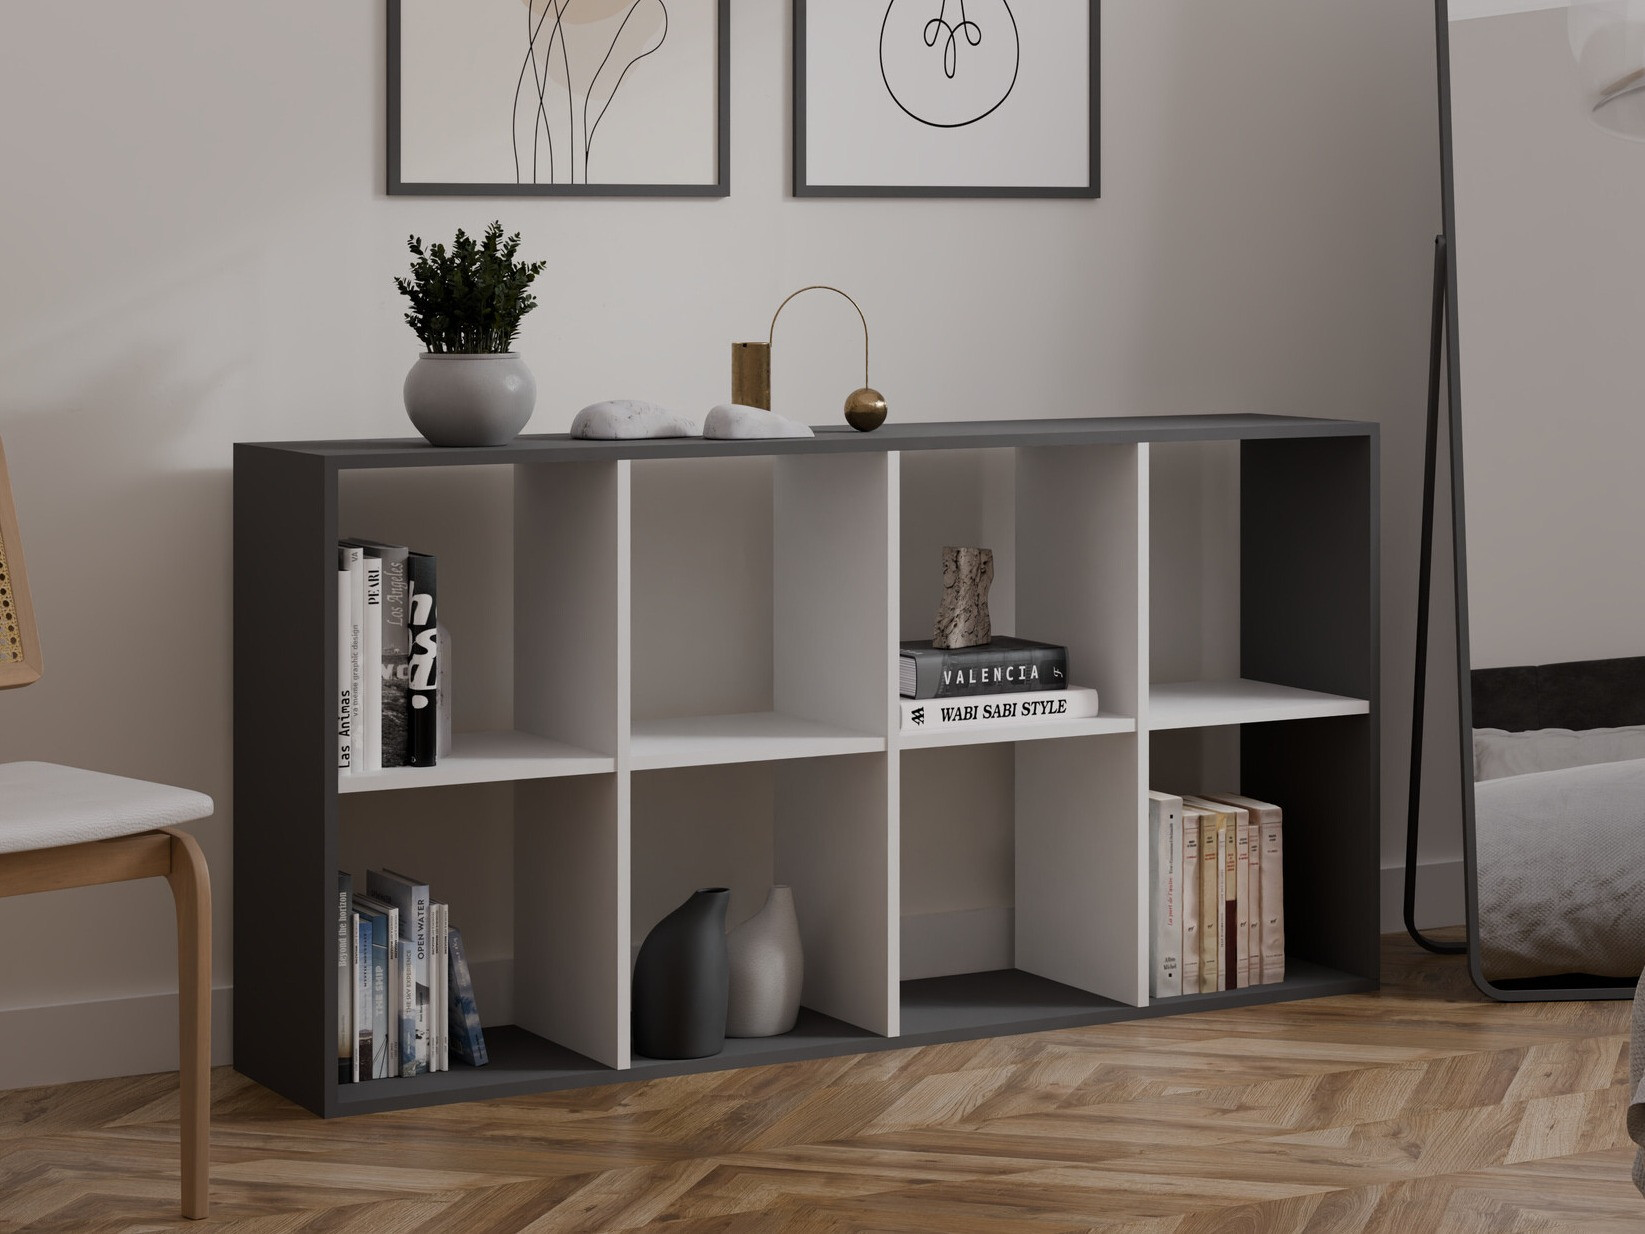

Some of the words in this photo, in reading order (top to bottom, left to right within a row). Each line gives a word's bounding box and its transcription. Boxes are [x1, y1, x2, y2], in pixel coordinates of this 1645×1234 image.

[367, 567, 380, 605] PEARL
[383, 561, 408, 605] Angeles
[386, 606, 404, 627] Los
[351, 624, 361, 650] design
[944, 664, 1039, 685] VALENCIA
[338, 690, 350, 737] Animas
[941, 704, 978, 722] WABI
[982, 702, 1017, 719] SABI
[1020, 699, 1068, 717] STYLE
[338, 745, 350, 768] Las
[338, 891, 347, 921] horizon
[417, 899, 425, 932] WATER
[338, 923, 347, 936] the
[338, 937, 348, 968] Beyond
[417, 933, 425, 960] OPEN
[375, 994, 384, 1016] THE
